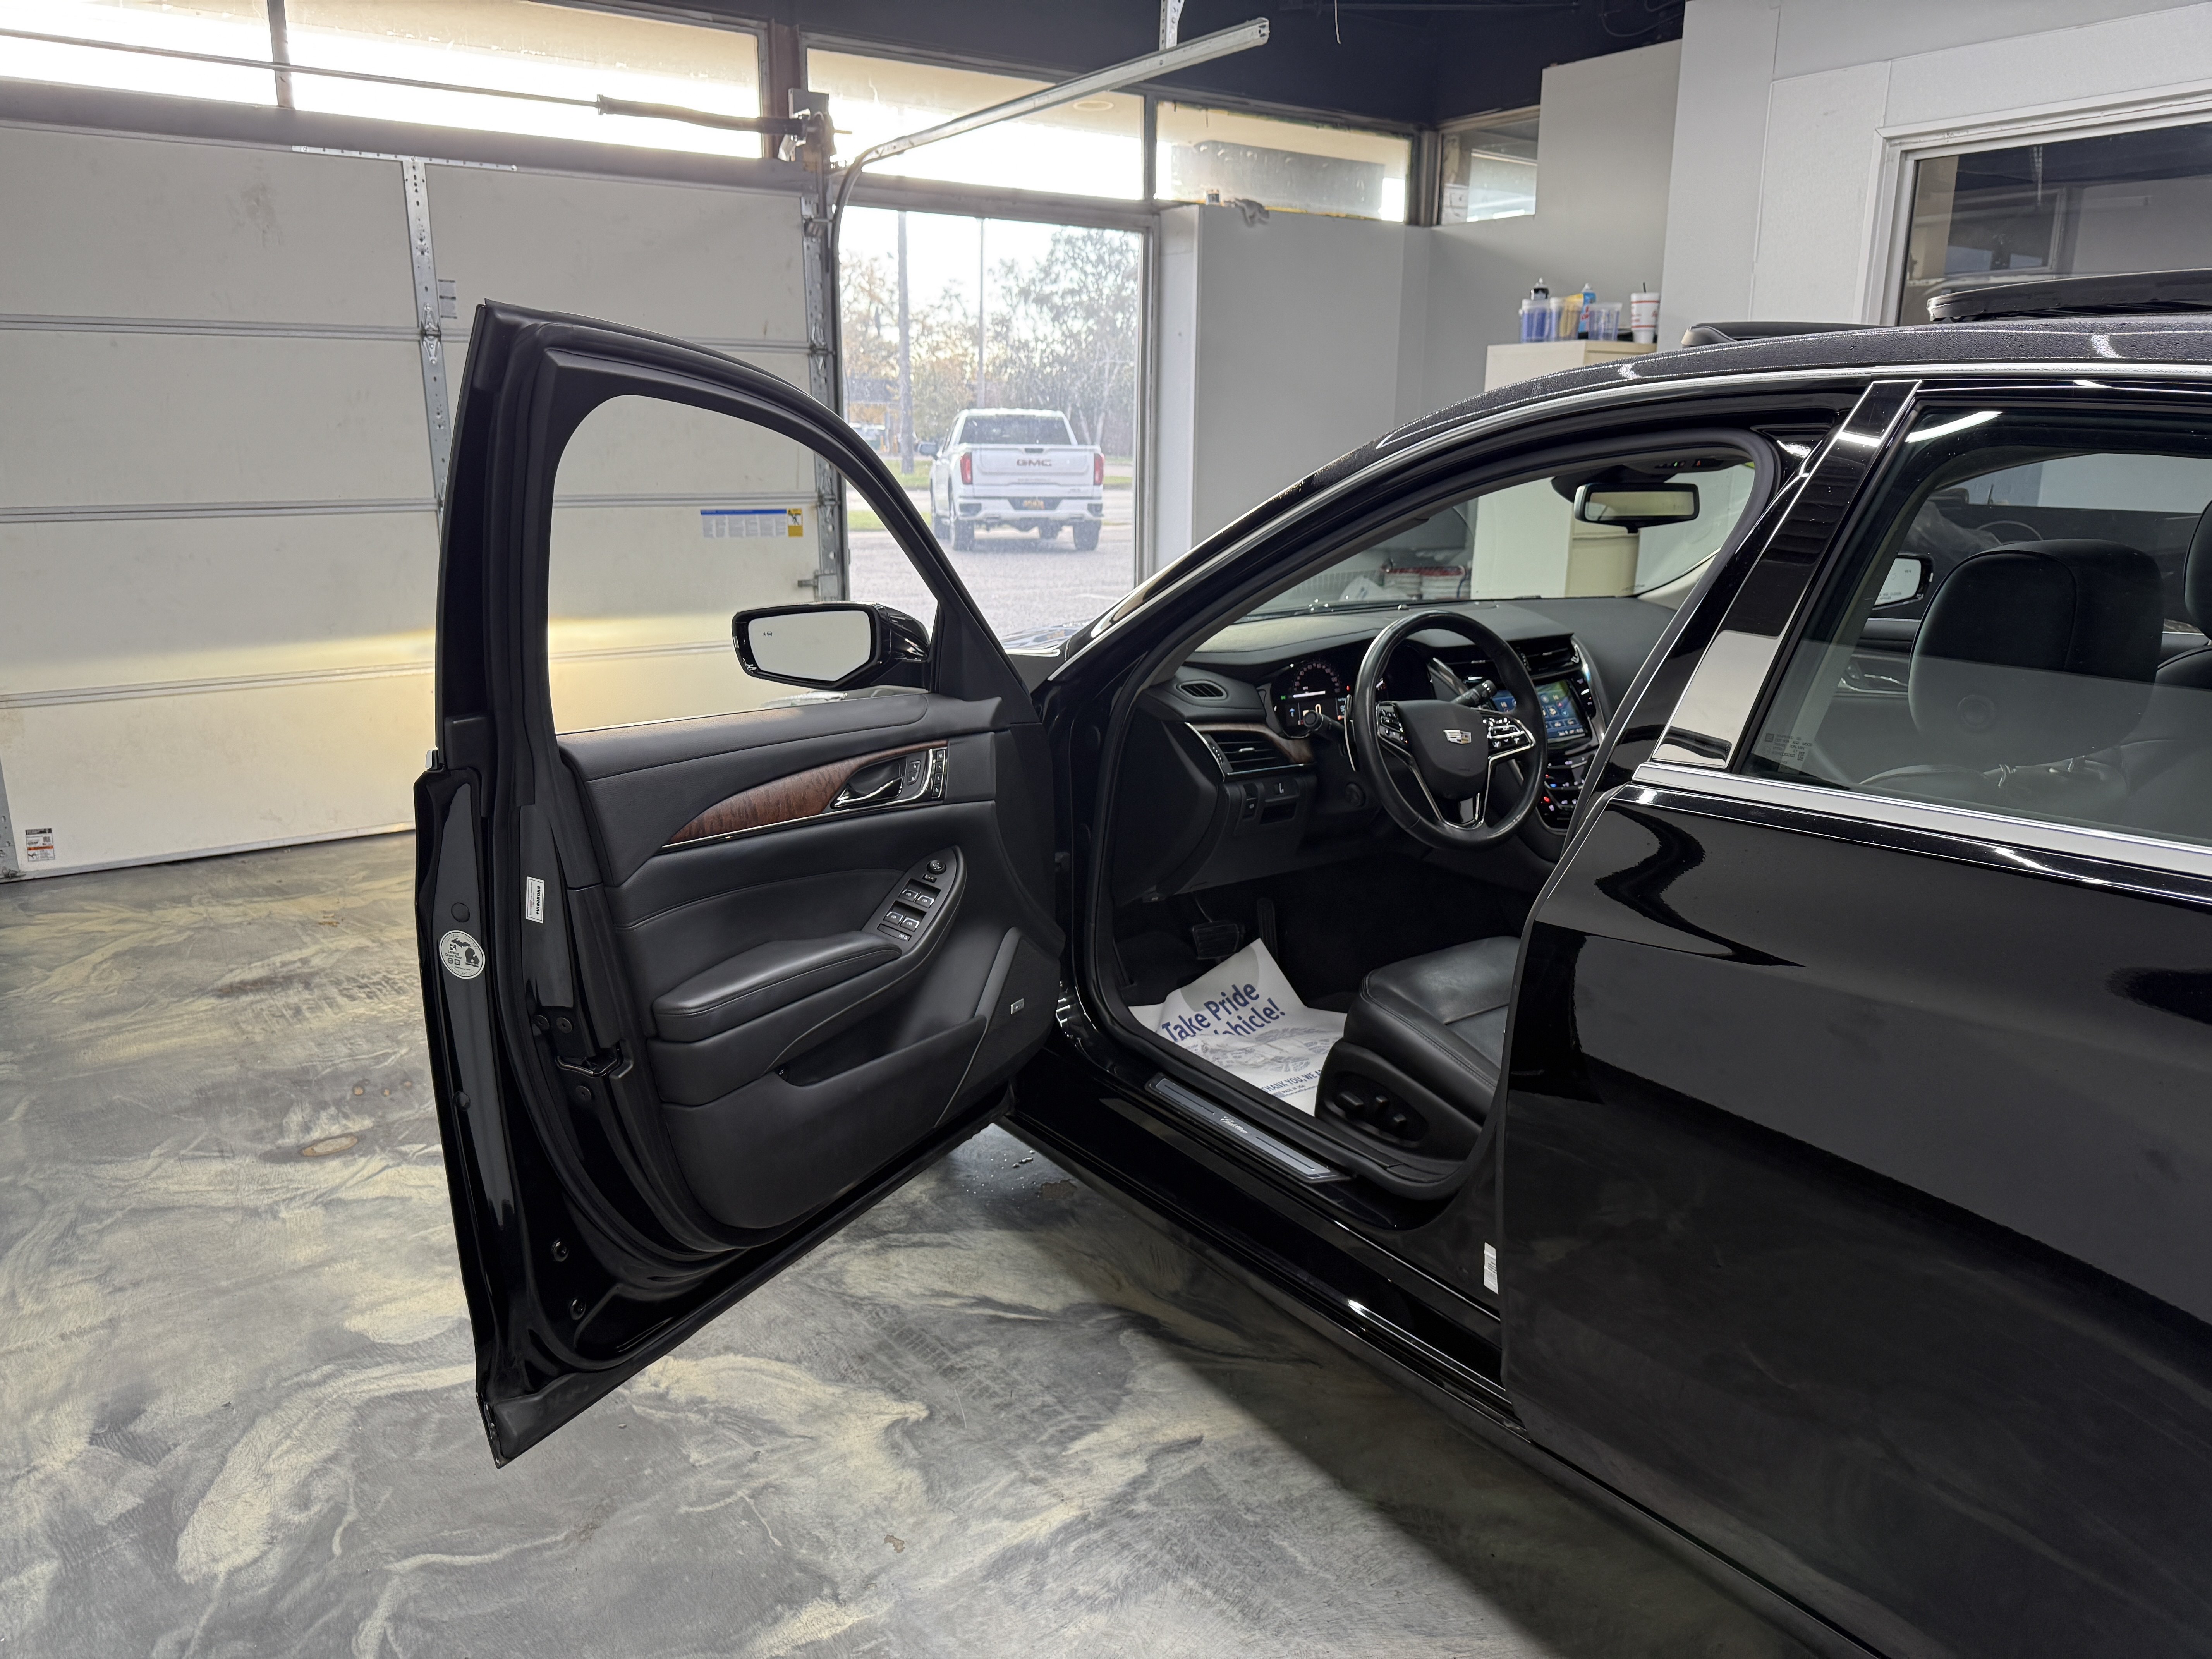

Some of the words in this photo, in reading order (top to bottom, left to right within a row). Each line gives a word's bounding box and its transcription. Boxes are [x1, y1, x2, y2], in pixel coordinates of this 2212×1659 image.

[1016, 459, 1052, 467] GMC
[1162, 1013, 1211, 1042] Take
[1204, 984, 1259, 1021] Pride
[1261, 1081, 1288, 1092] THANK
[1284, 1076, 1307, 1085] YOU,
